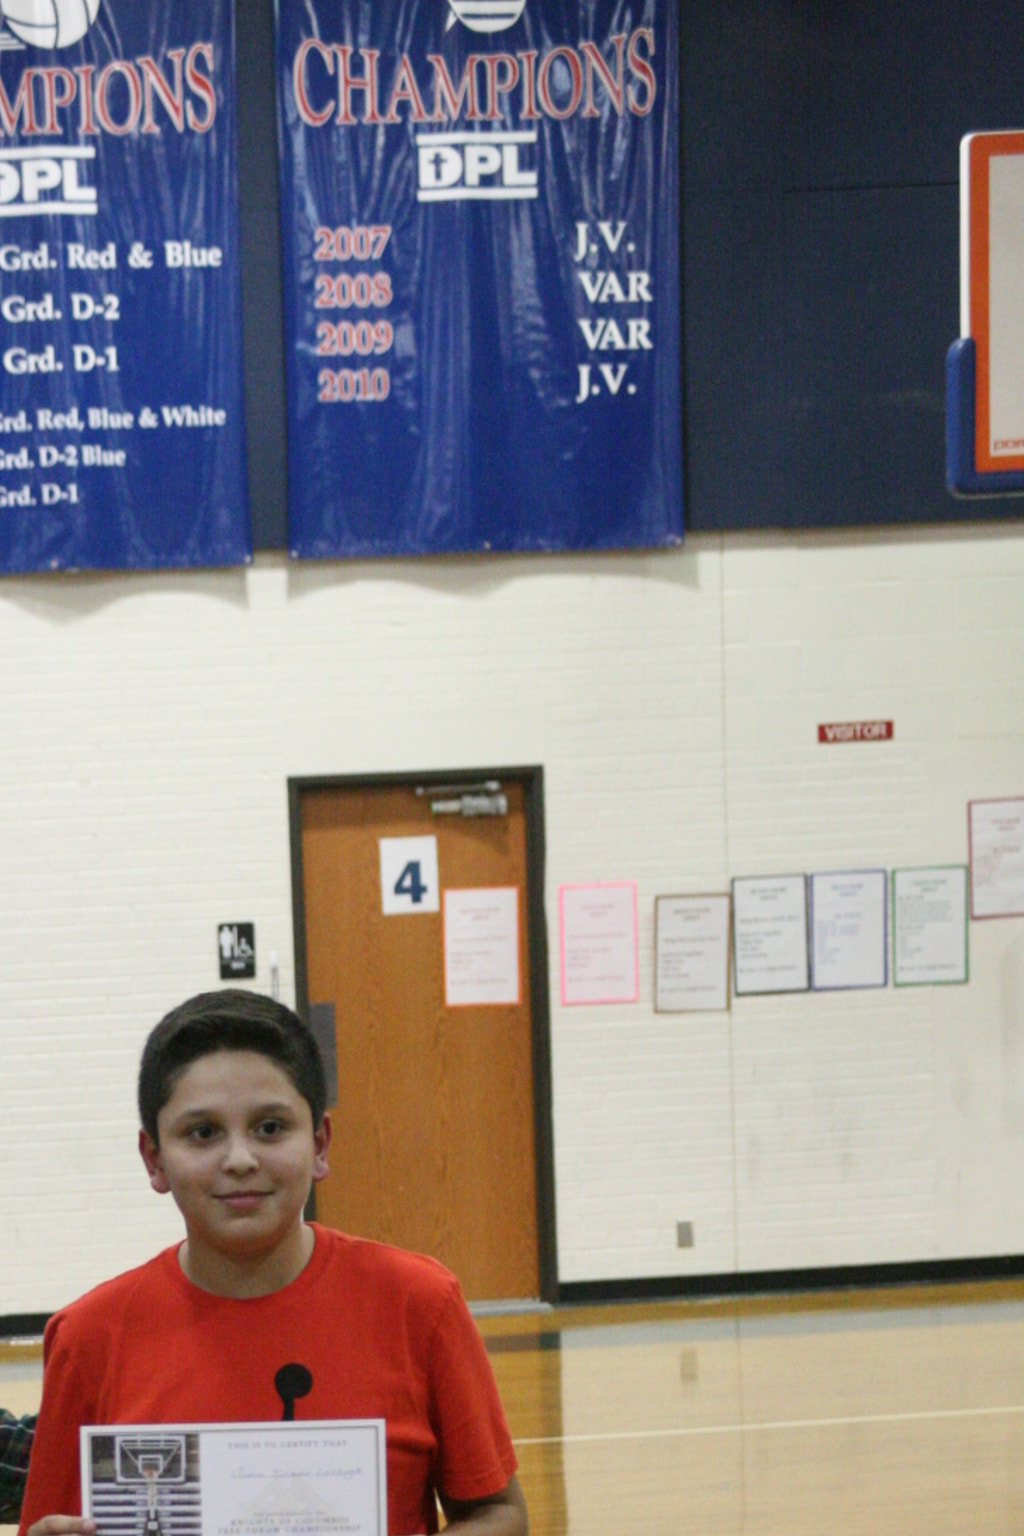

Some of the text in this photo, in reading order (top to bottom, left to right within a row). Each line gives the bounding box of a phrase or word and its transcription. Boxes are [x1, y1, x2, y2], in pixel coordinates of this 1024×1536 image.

[293, 27, 656, 126] CHAMPIONS
[419, 144, 537, 188] DPL
[68, 243, 116, 269] Red
[128, 243, 153, 268] &
[165, 241, 222, 268] Blue
[313, 222, 635, 262] 2007 J.V.
[314, 272, 653, 308] 2008 VAR
[2, 294, 62, 322] Grd.
[72, 294, 119, 320] D-2
[316, 319, 653, 356] 2009 VAR
[3, 346, 63, 374] Grd.
[73, 346, 119, 372] D-1
[318, 364, 636, 403] 2010 J.V.
[37, 407, 85, 432] Red,
[88, 407, 133, 429] Blue
[138, 407, 158, 428] &
[162, 405, 226, 428] White
[39, 446, 77, 467] D-2
[82, 445, 126, 466] Blue
[41, 483, 79, 504] D-1
[824, 720, 888, 741] VISITOR
[393, 861, 428, 904] 4
